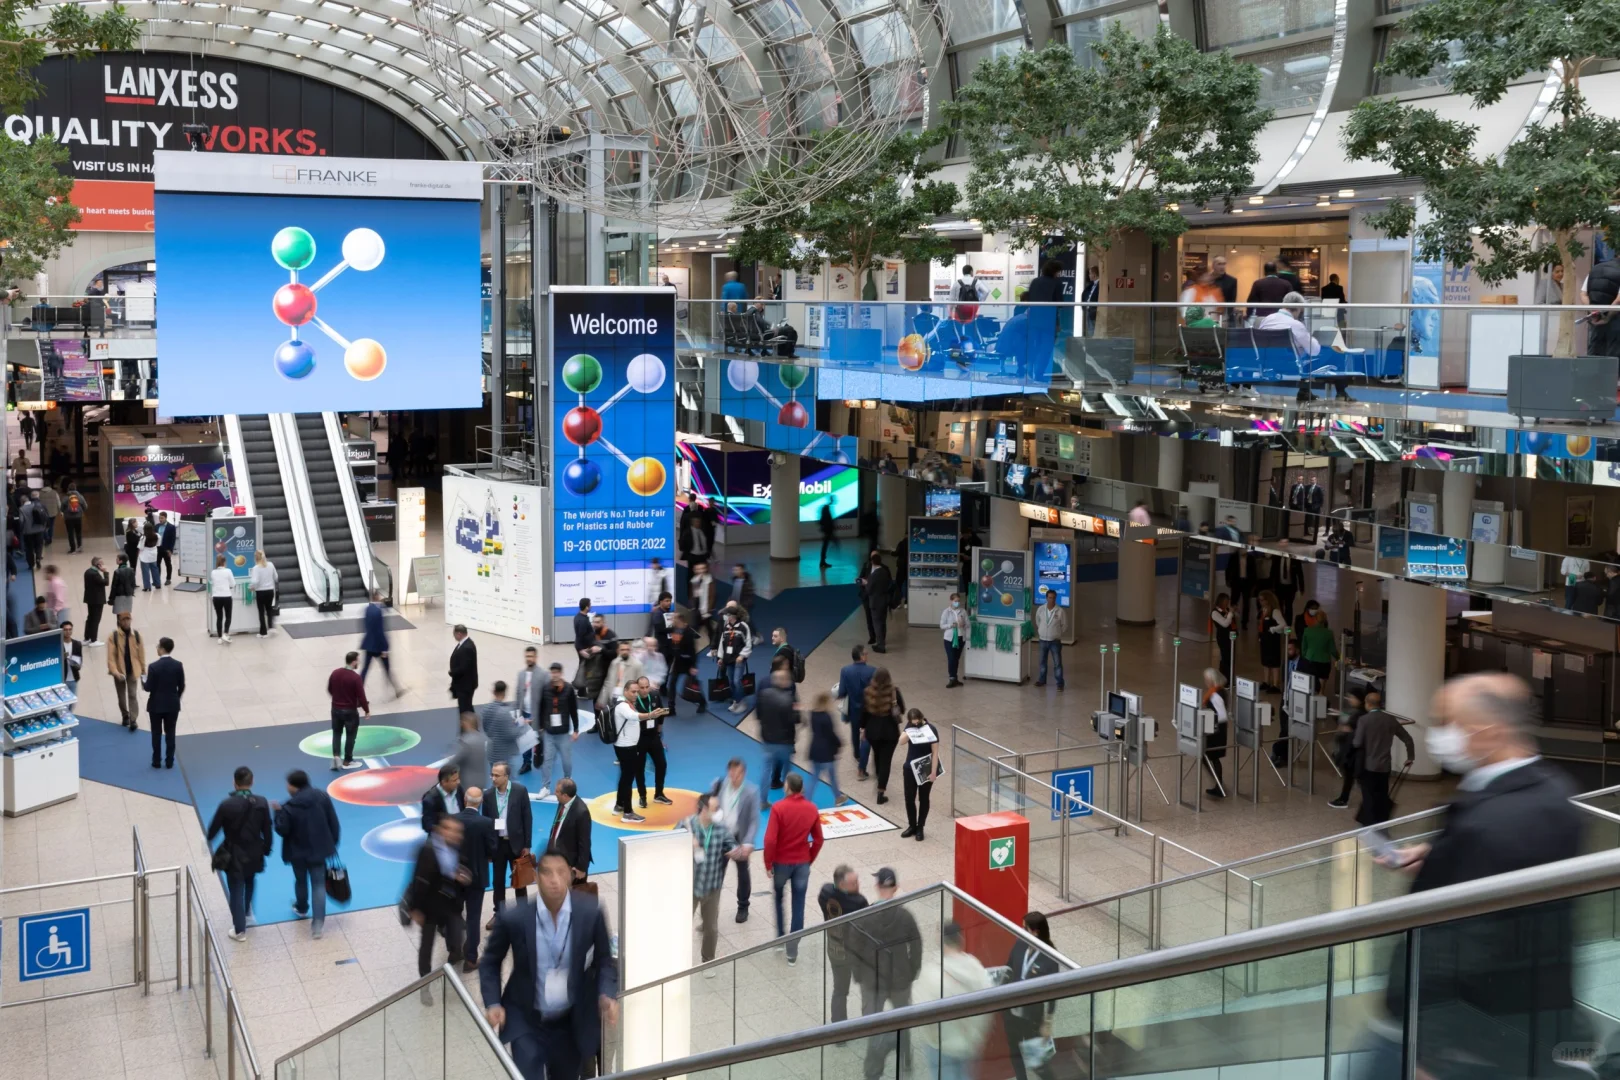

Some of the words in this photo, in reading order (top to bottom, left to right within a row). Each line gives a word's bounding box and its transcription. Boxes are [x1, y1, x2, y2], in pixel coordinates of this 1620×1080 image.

[104, 64, 239, 110] LANXESS
[4, 113, 173, 149] QUALITY
[73, 161, 105, 171] VISIT
[107, 162, 124, 173] US
[127, 163, 140, 173] IN
[297, 169, 377, 183] FRANKE
[86, 207, 106, 215] heart
[1062, 281, 1073, 295] 7.2
[570, 312, 658, 335] Welcome
[563, 511, 578, 520] The
[580, 510, 608, 519] World's
[628, 509, 649, 518] Trade
[651, 508, 666, 517] Fair
[563, 522, 574, 531] for
[576, 521, 608, 530] Plastics
[609, 520, 625, 529] and
[626, 520, 654, 529] Rubber
[236, 539, 254, 548] 2022
[927, 533, 957, 541] Information
[594, 539, 640, 551] OCTOBER
[641, 537, 666, 550] 2022
[1003, 575, 1023, 586] 2022
[20, 657, 59, 673] Information
